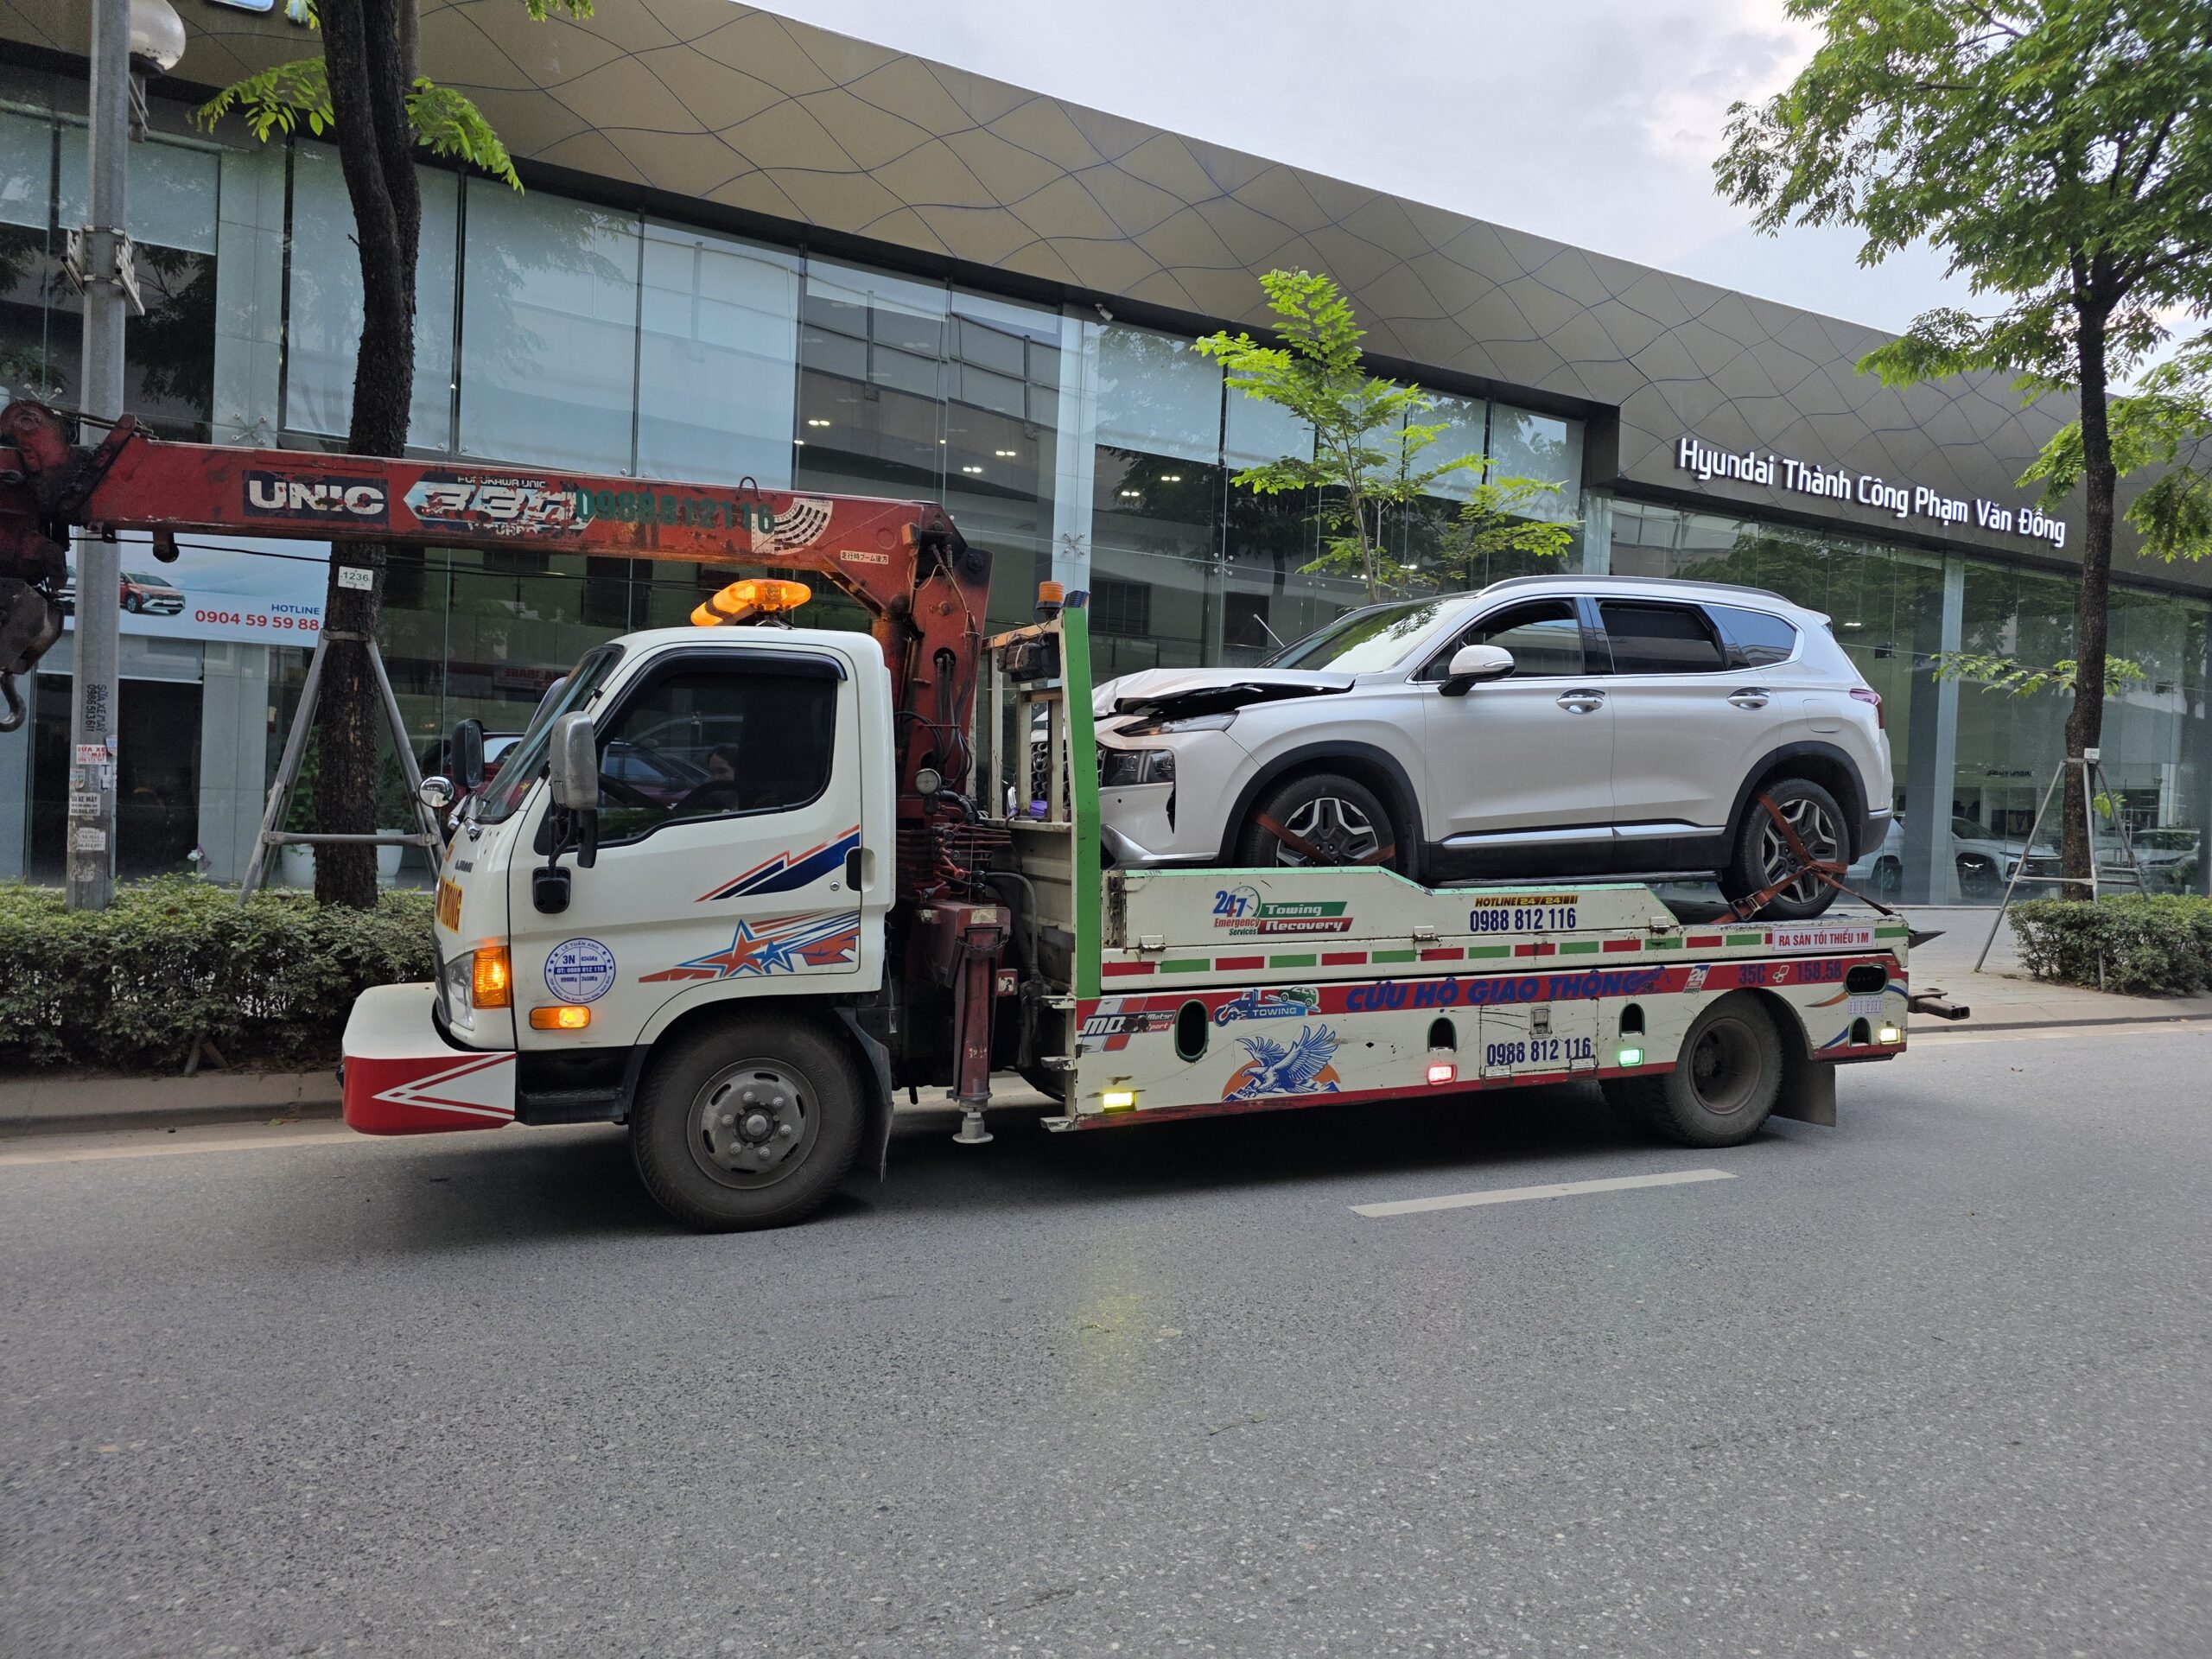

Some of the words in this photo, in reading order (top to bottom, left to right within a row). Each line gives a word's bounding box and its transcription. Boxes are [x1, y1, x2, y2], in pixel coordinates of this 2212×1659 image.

[248, 480, 385, 515] UNIC
[1679, 437, 1774, 486] Hyundai
[1782, 458, 1851, 500] Thành
[1857, 474, 1909, 518] Công
[1915, 486, 1968, 526] Phạm
[1976, 499, 2012, 531] Văn
[2018, 506, 2066, 548] Đồng
[271, 603, 321, 615] HOTLINE
[194, 609, 240, 625] 0904
[245, 613, 268, 626] 59
[272, 616, 294, 629] 59
[297, 618, 320, 631] 88
[1265, 904, 1323, 917] Towing
[1475, 896, 1517, 907] HOTLINE
[1213, 918, 1262, 928] Emergency
[1265, 920, 1344, 931] Recovery
[1470, 909, 1510, 932] 0988
[1515, 908, 1543, 930] 812
[1548, 907, 1576, 929] 116
[1778, 935, 1790, 946] RA
[1814, 930, 1827, 945] TỐI
[1829, 928, 1853, 944] THIỂU
[1856, 932, 1869, 944] 1M
[563, 955, 575, 964] 3N
[1738, 963, 1766, 984] 35C
[1346, 980, 1408, 1011] CỨU
[1414, 976, 1460, 1013] HỘ
[1468, 978, 1541, 1004] GIAO
[1548, 969, 1645, 1001] THÔNG
[1252, 1007, 1297, 1017] TOWING
[1486, 1041, 1526, 1066] 0988
[1530, 1039, 1559, 1062] 812
[1565, 1037, 1592, 1059] 116
